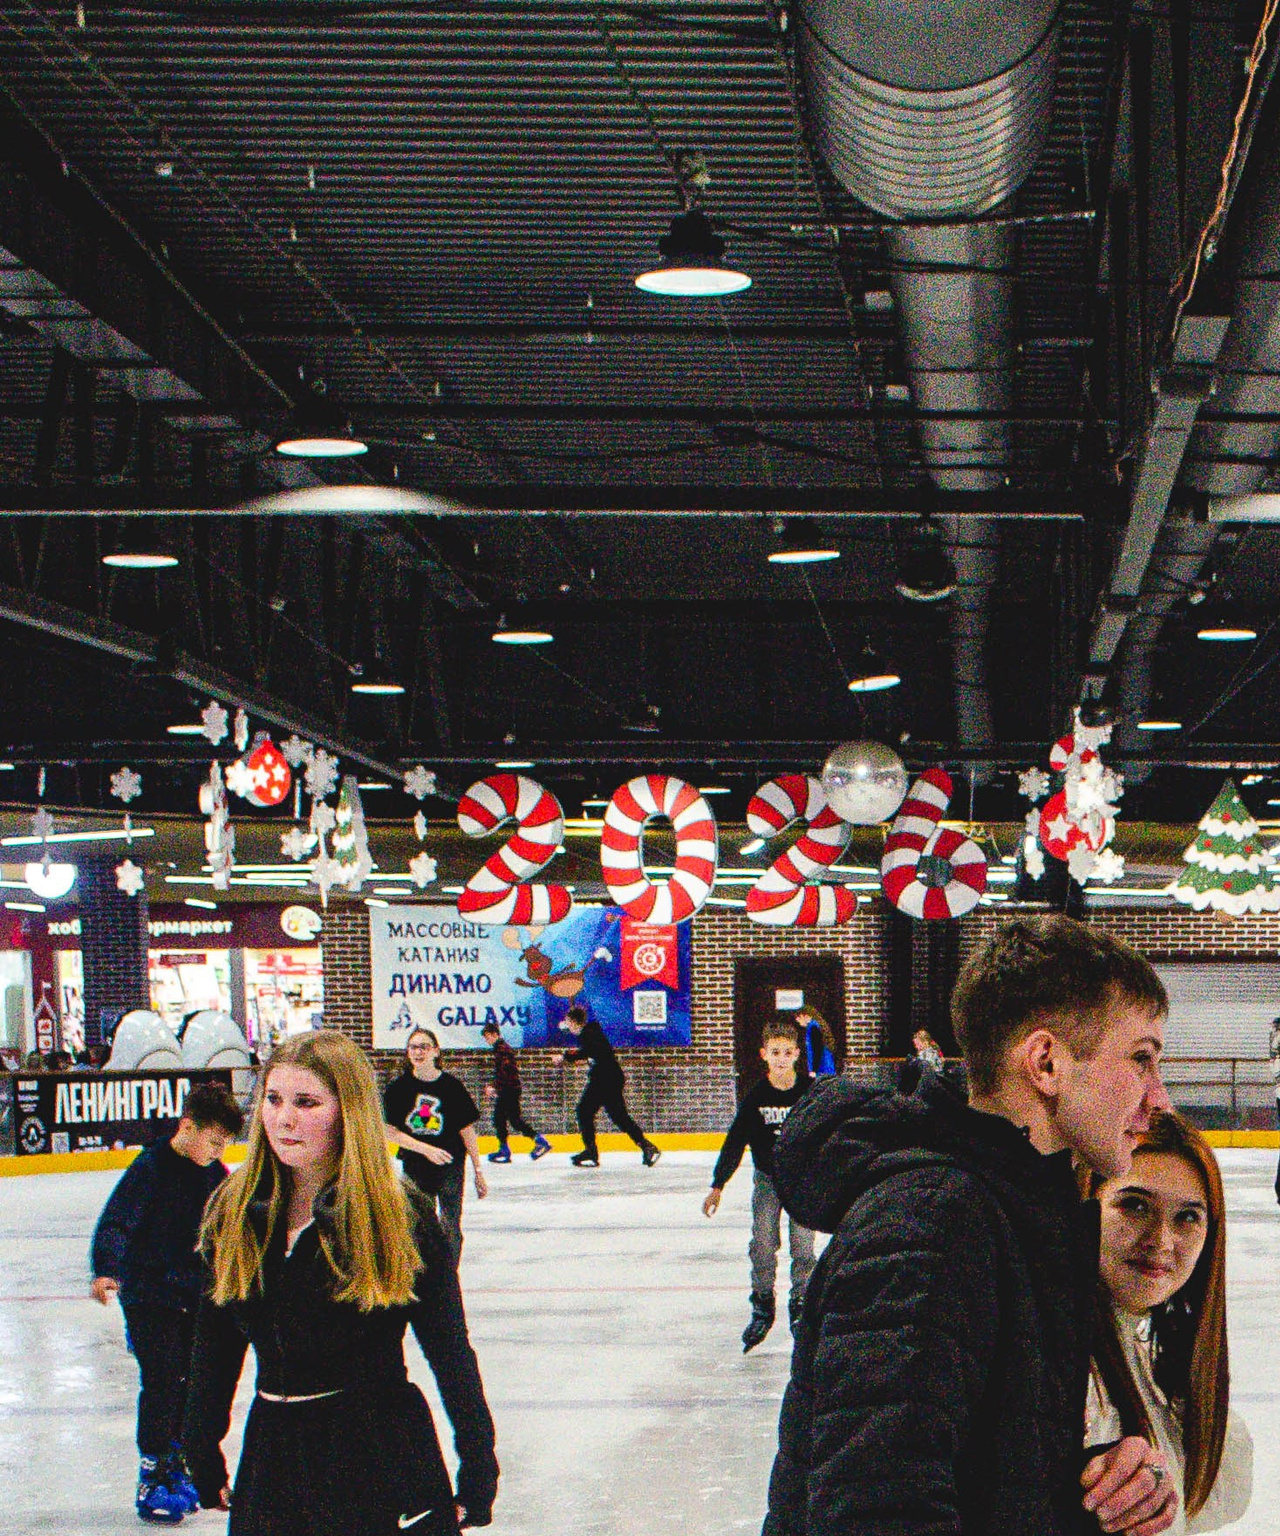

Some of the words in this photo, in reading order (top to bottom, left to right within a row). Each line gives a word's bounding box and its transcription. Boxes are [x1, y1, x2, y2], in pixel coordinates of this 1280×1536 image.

[48, 919, 82, 935] хоб
[388, 922, 489, 938] МАССОВЫЕ
[398, 946, 480, 962] КАТАНИЯ
[389, 973, 491, 997] ДИНАМО
[437, 1005, 531, 1026] GALAXY
